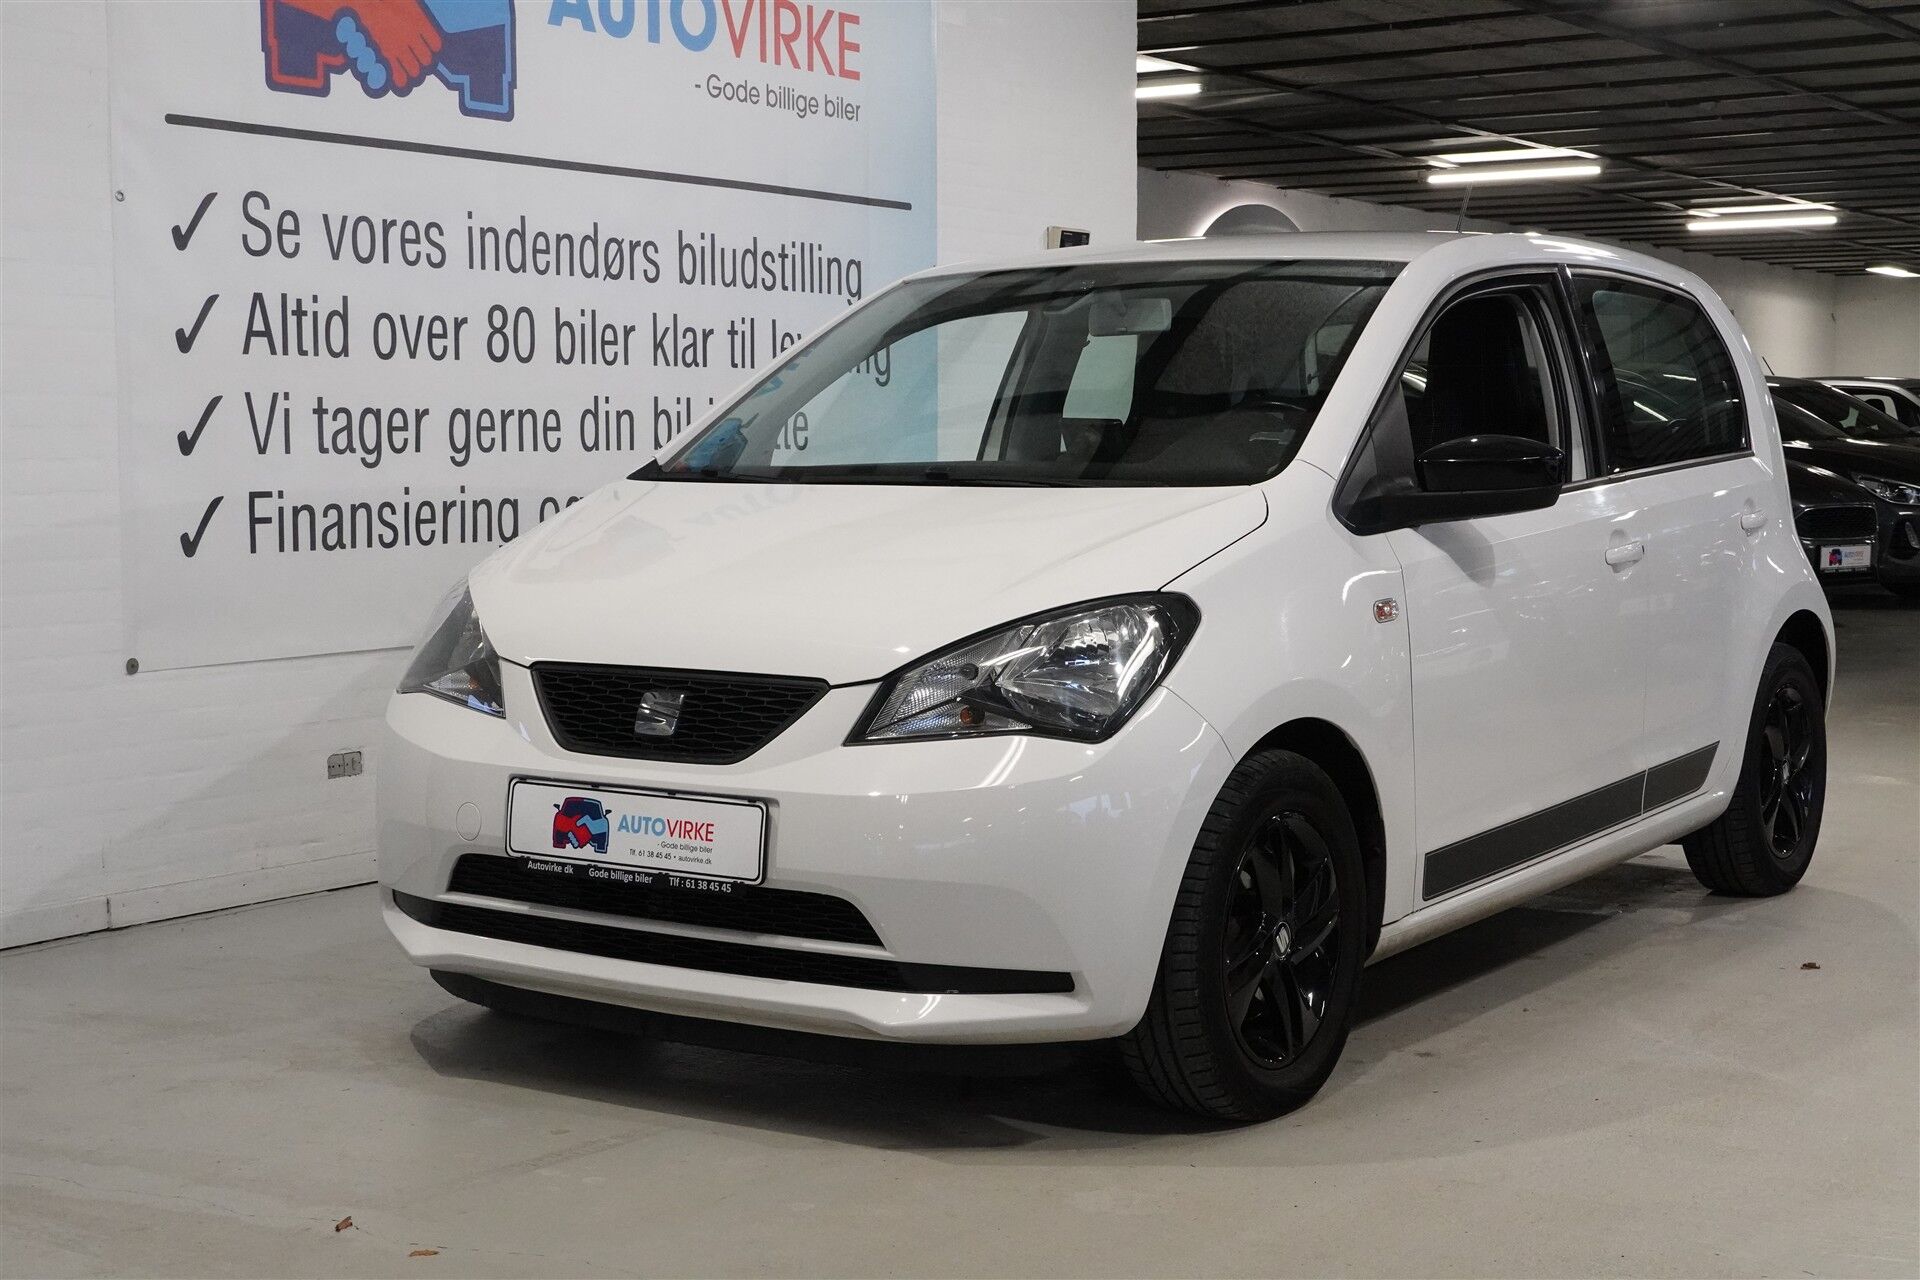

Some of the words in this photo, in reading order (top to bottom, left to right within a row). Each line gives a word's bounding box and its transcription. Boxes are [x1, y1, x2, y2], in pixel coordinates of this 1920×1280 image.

[706, 73, 761, 105] Gode
[766, 84, 819, 119] billige
[824, 94, 861, 122] biler
[241, 190, 301, 259] Se
[321, 213, 447, 269] vores
[467, 210, 661, 284] indendørs
[677, 229, 862, 307] biludstilling
[242, 291, 350, 359] Altid
[372, 312, 469, 362] over
[486, 303, 536, 364] 80
[554, 306, 636, 367] biler
[652, 312, 715, 369] klar
[726, 317, 756, 370] til
[244, 391, 291, 455] Vi
[312, 396, 430, 470] tager
[448, 407, 562, 468] gerne
[579, 395, 635, 453] din
[653, 395, 692, 451] bil
[248, 484, 520, 555] Finansiering
[617, 814, 714, 842] AUTOVIRKE
[661, 841, 678, 850] Gode
[680, 843, 699, 853] billige
[700, 846, 713, 854] biler
[527, 860, 563, 873] Autovirke
[588, 868, 609, 879] Gode
[610, 870, 634, 884] billige
[635, 873, 653, 884] biler
[685, 879, 695, 889] 61
[697, 880, 707, 890] 38
[709, 881, 720, 892] 45
[721, 882, 732, 893] 45
[638, 849, 646, 857] 61
[647, 850, 654, 858] 38
[655, 851, 663, 859] 45
[664, 852, 672, 860] 45
